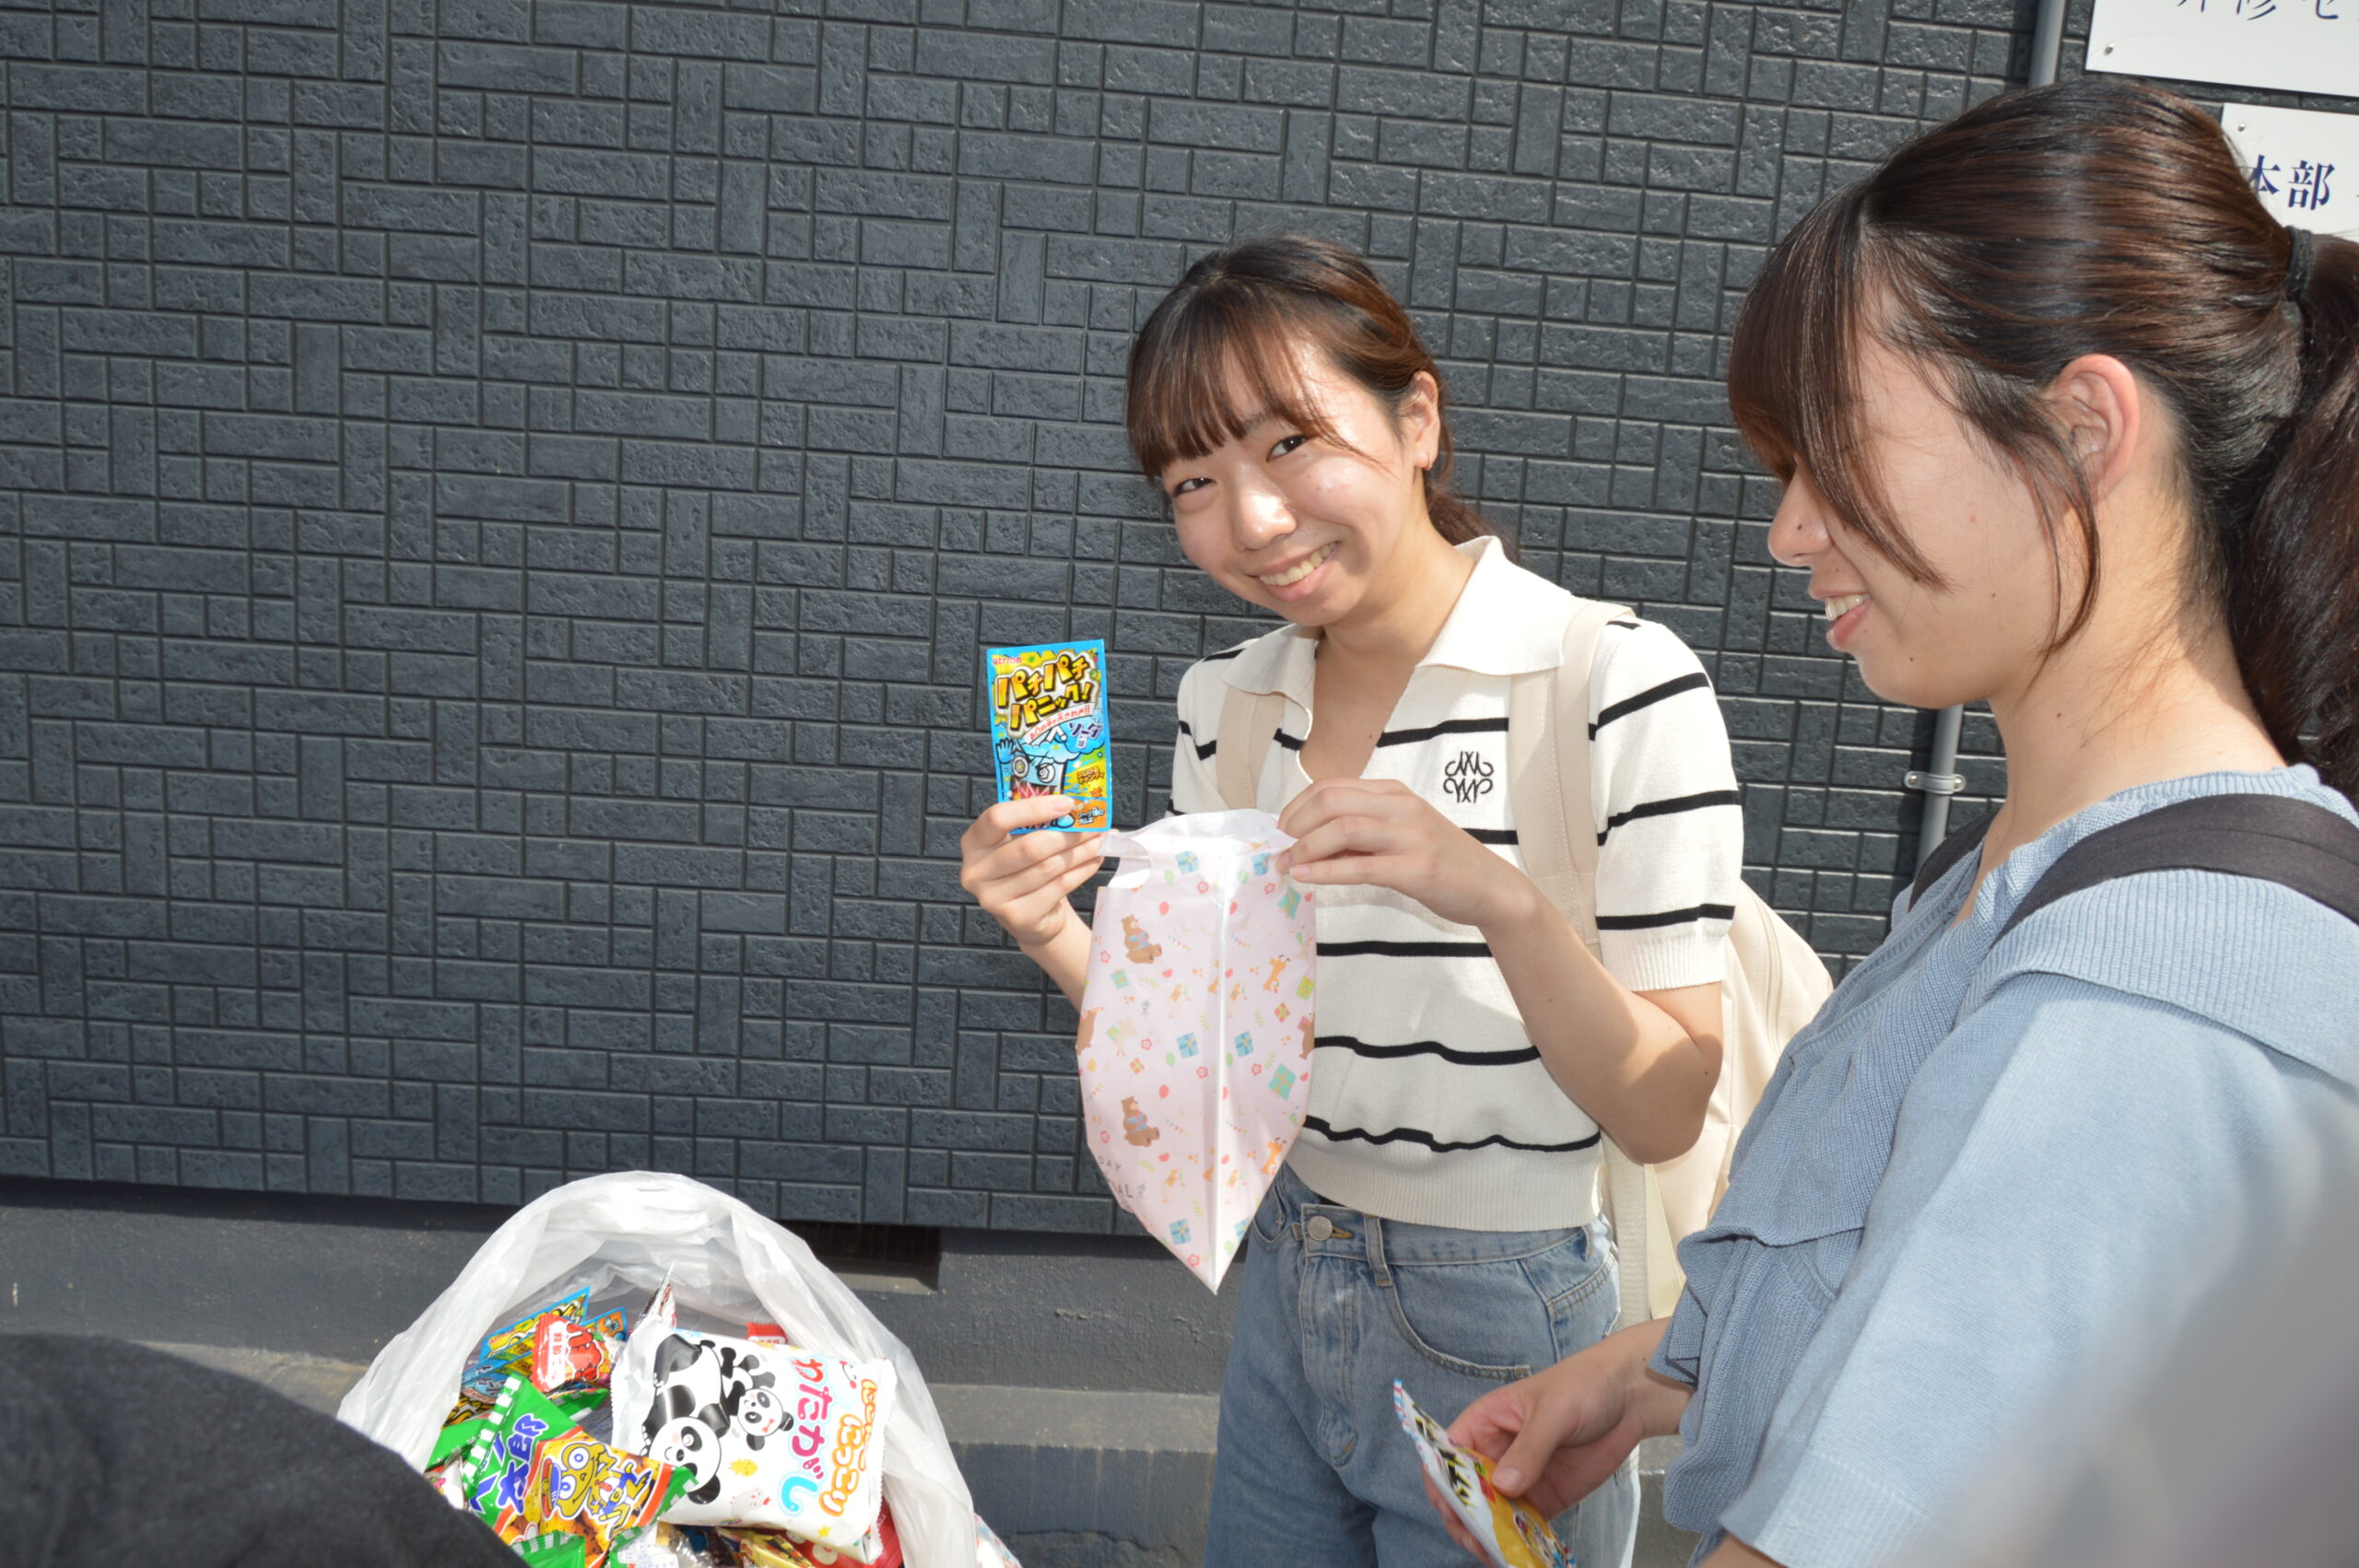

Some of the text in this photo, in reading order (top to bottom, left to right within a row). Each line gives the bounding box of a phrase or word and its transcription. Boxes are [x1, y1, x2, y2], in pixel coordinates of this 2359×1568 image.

[995, 653, 1089, 709] パチパチ
[496, 1412, 549, 1515] 太郎
[780, 1358, 833, 1514] わたがし
[818, 1413, 864, 1518] にっこり
